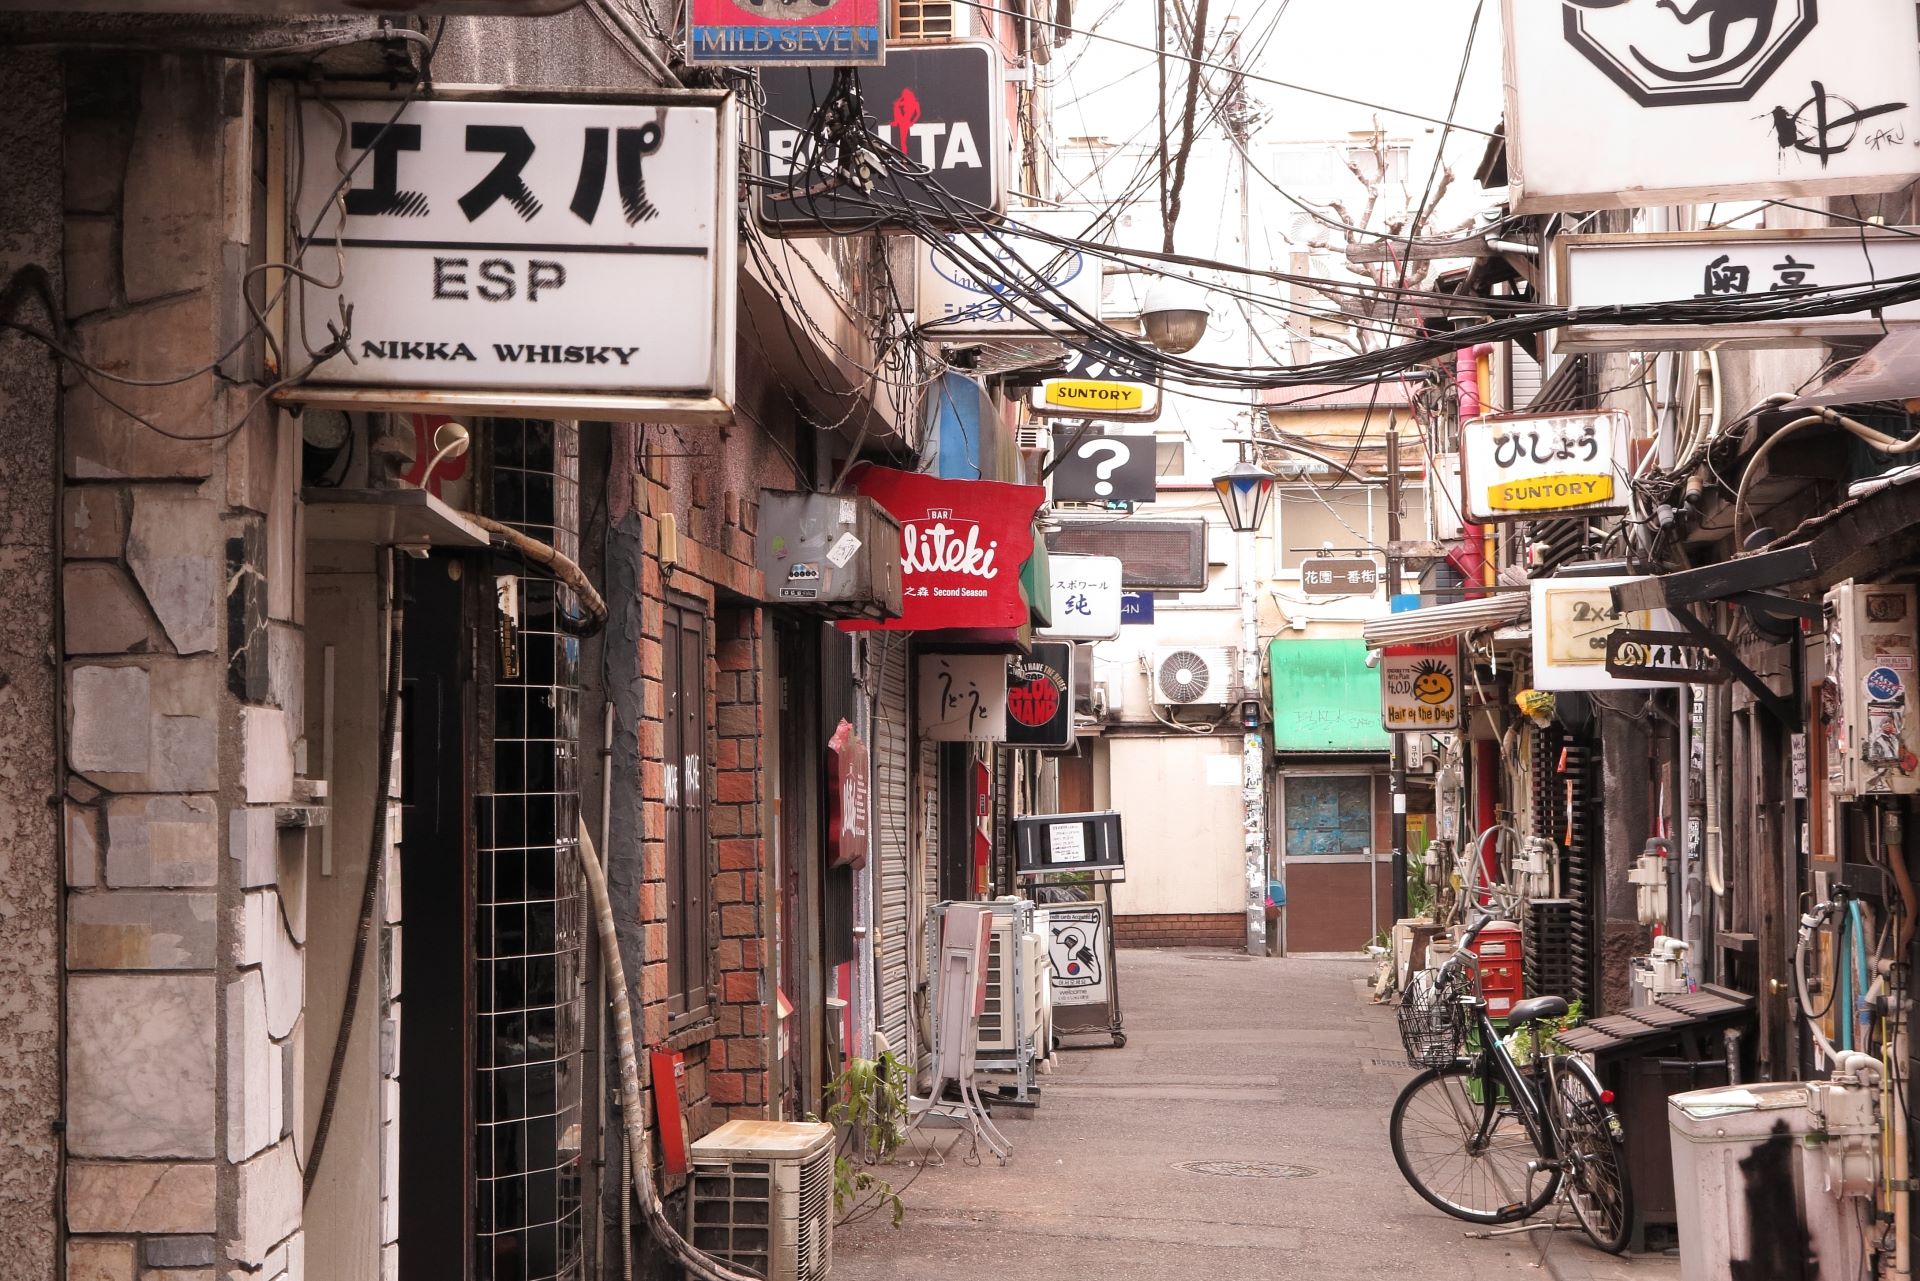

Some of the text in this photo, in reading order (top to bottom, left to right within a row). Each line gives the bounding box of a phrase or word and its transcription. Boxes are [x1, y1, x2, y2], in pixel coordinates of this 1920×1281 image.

[702, 29, 870, 52] MILD SEVEN
[1864, 121, 1906, 151] SARU
[346, 121, 662, 227] エスパ
[431, 257, 568, 303] ESP
[360, 339, 640, 366] NIKKA WHISKY
[1058, 387, 1132, 401] SUNTORY
[1494, 427, 1599, 469] ひしょう
[1503, 480, 1598, 502] SUNTORY
[931, 510, 949, 520] BAR
[1050, 580, 1109, 591] スポワール
[1304, 569, 1376, 585] 花園一番街
[933, 586, 960, 598] Second
[961, 587, 988, 598] Season
[1064, 593, 1092, 616] 純
[1009, 699, 1058, 725] HAND
[1388, 706, 1406, 723] Hair
[1408, 709, 1416, 723] of
[1418, 706, 1432, 720] the
[1434, 706, 1454, 722] Dogs
